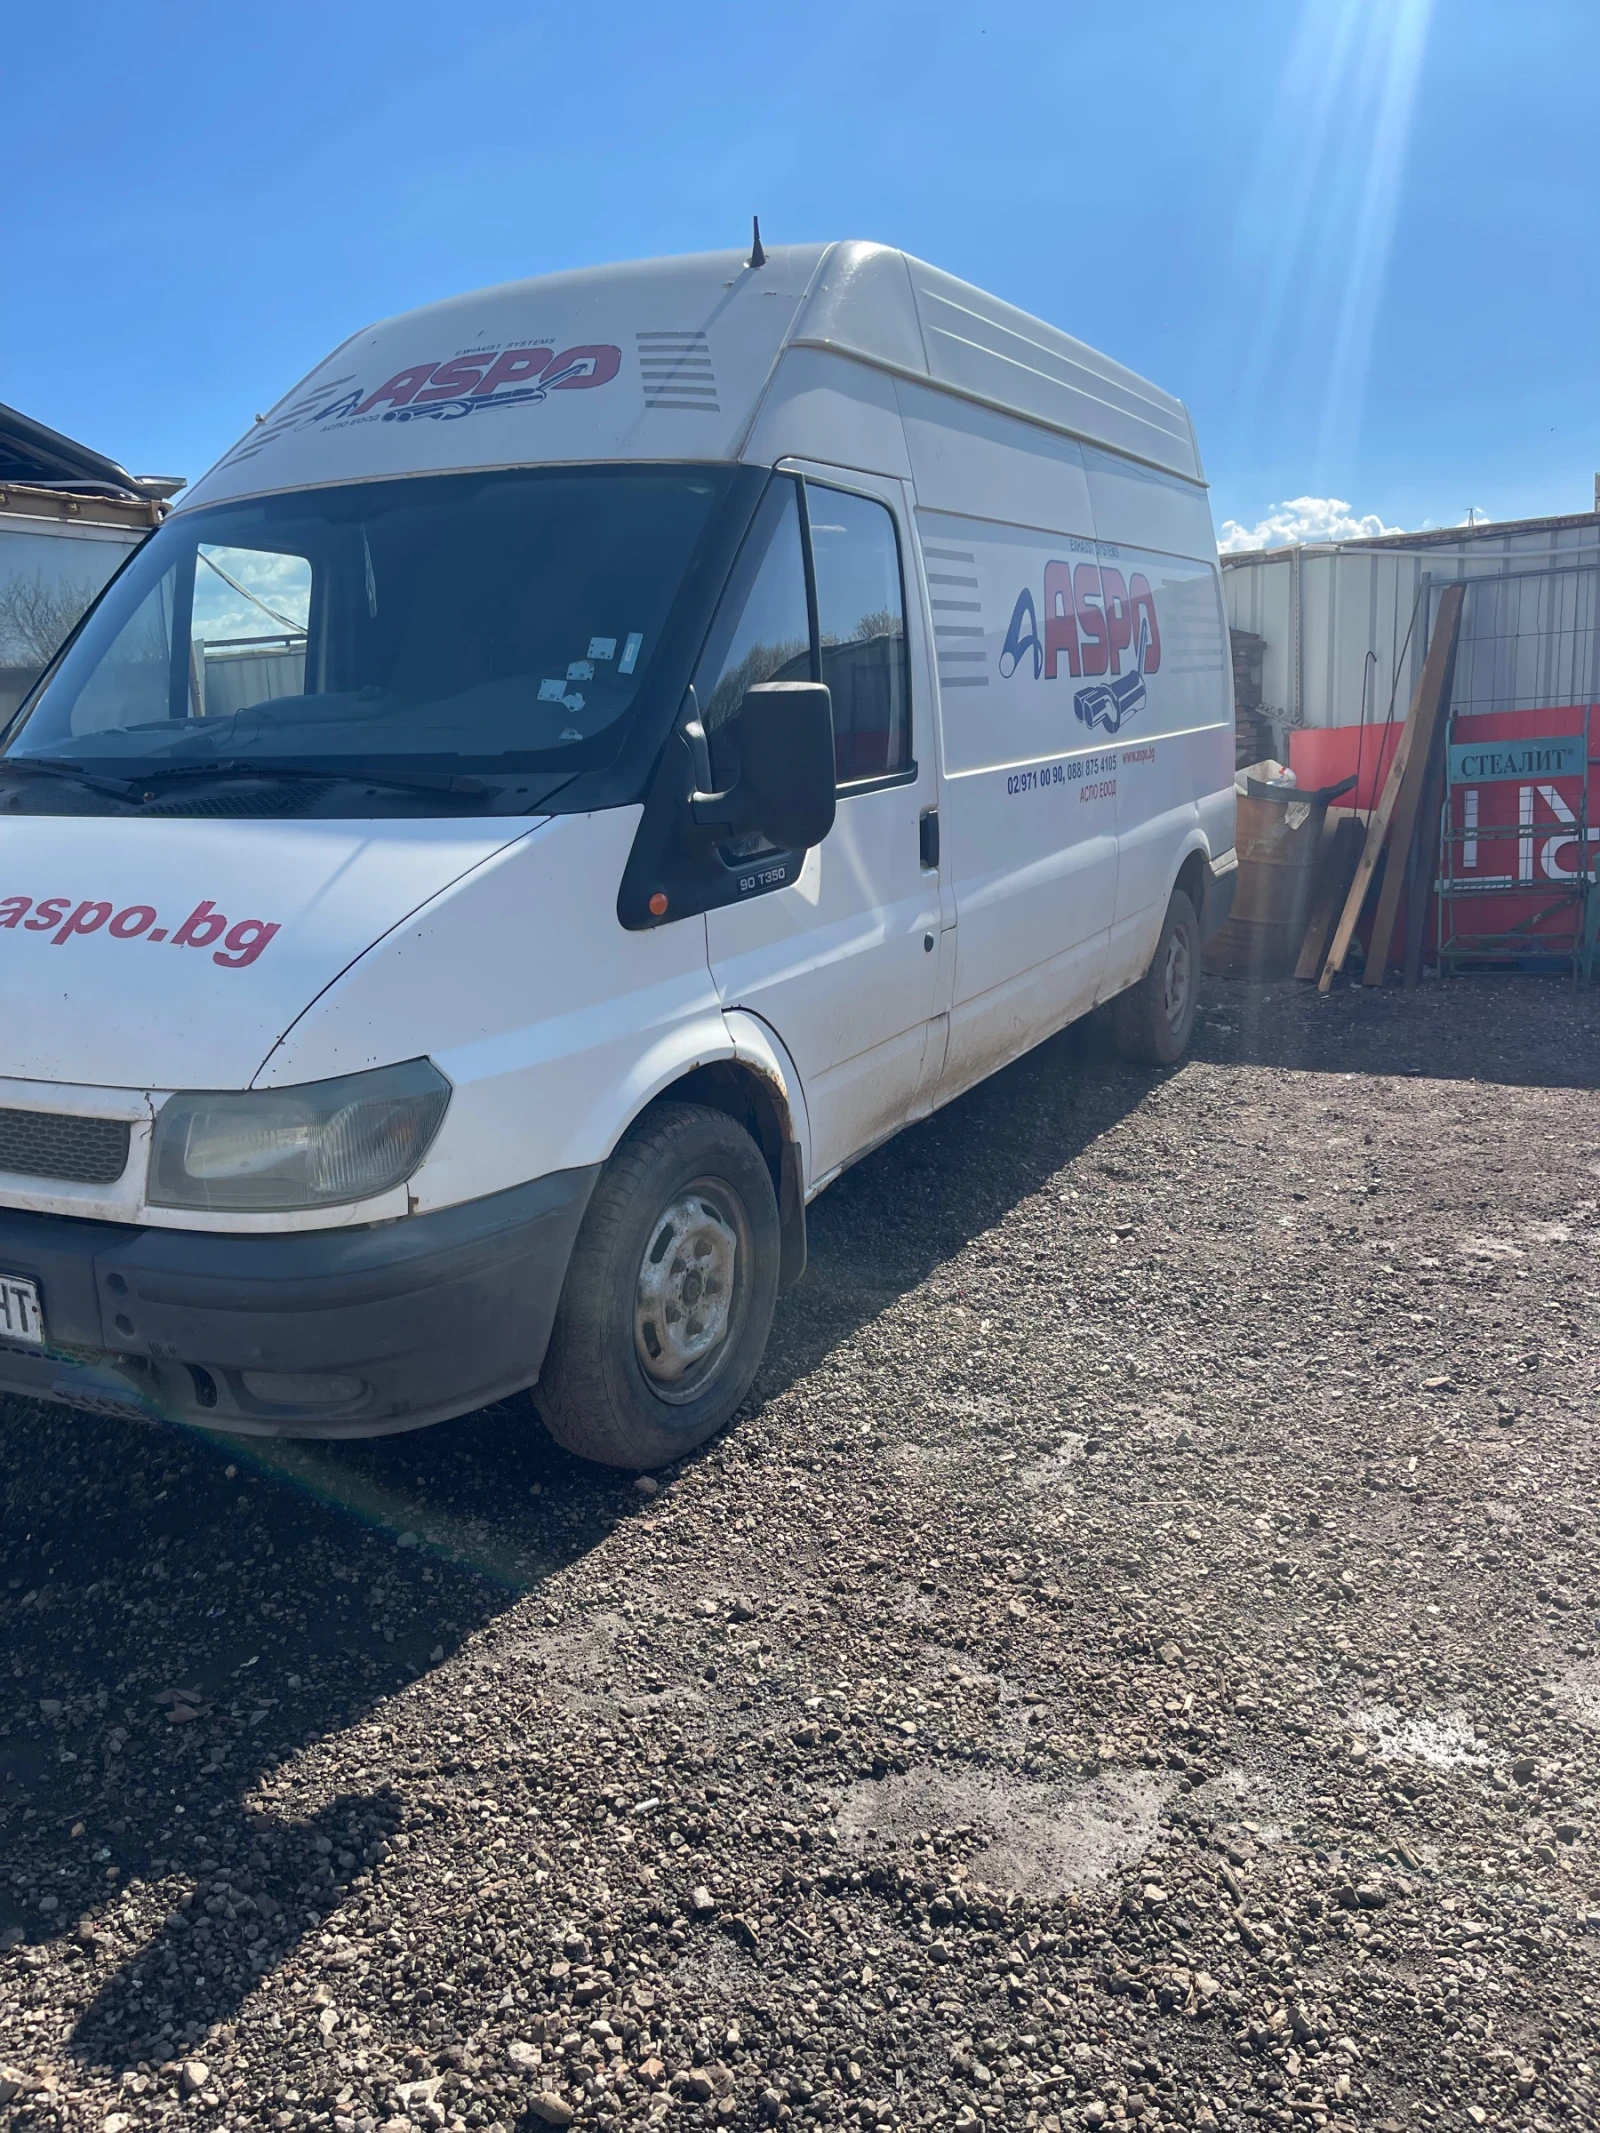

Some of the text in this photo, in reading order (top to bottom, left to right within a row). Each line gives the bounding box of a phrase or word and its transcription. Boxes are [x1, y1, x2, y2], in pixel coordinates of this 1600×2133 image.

[454, 338, 556, 357] EXHAUST SYSTEMS
[348, 344, 622, 417] ASPO
[1043, 559, 1161, 680] ASPO
[1040, 768, 1051, 787] 00
[1052, 765, 1066, 785] 90,
[1085, 759, 1099, 776] 875
[1100, 755, 1117, 772] 4105
[1080, 783, 1099, 803] АСПО
[740, 867, 786, 891] 90 T350
